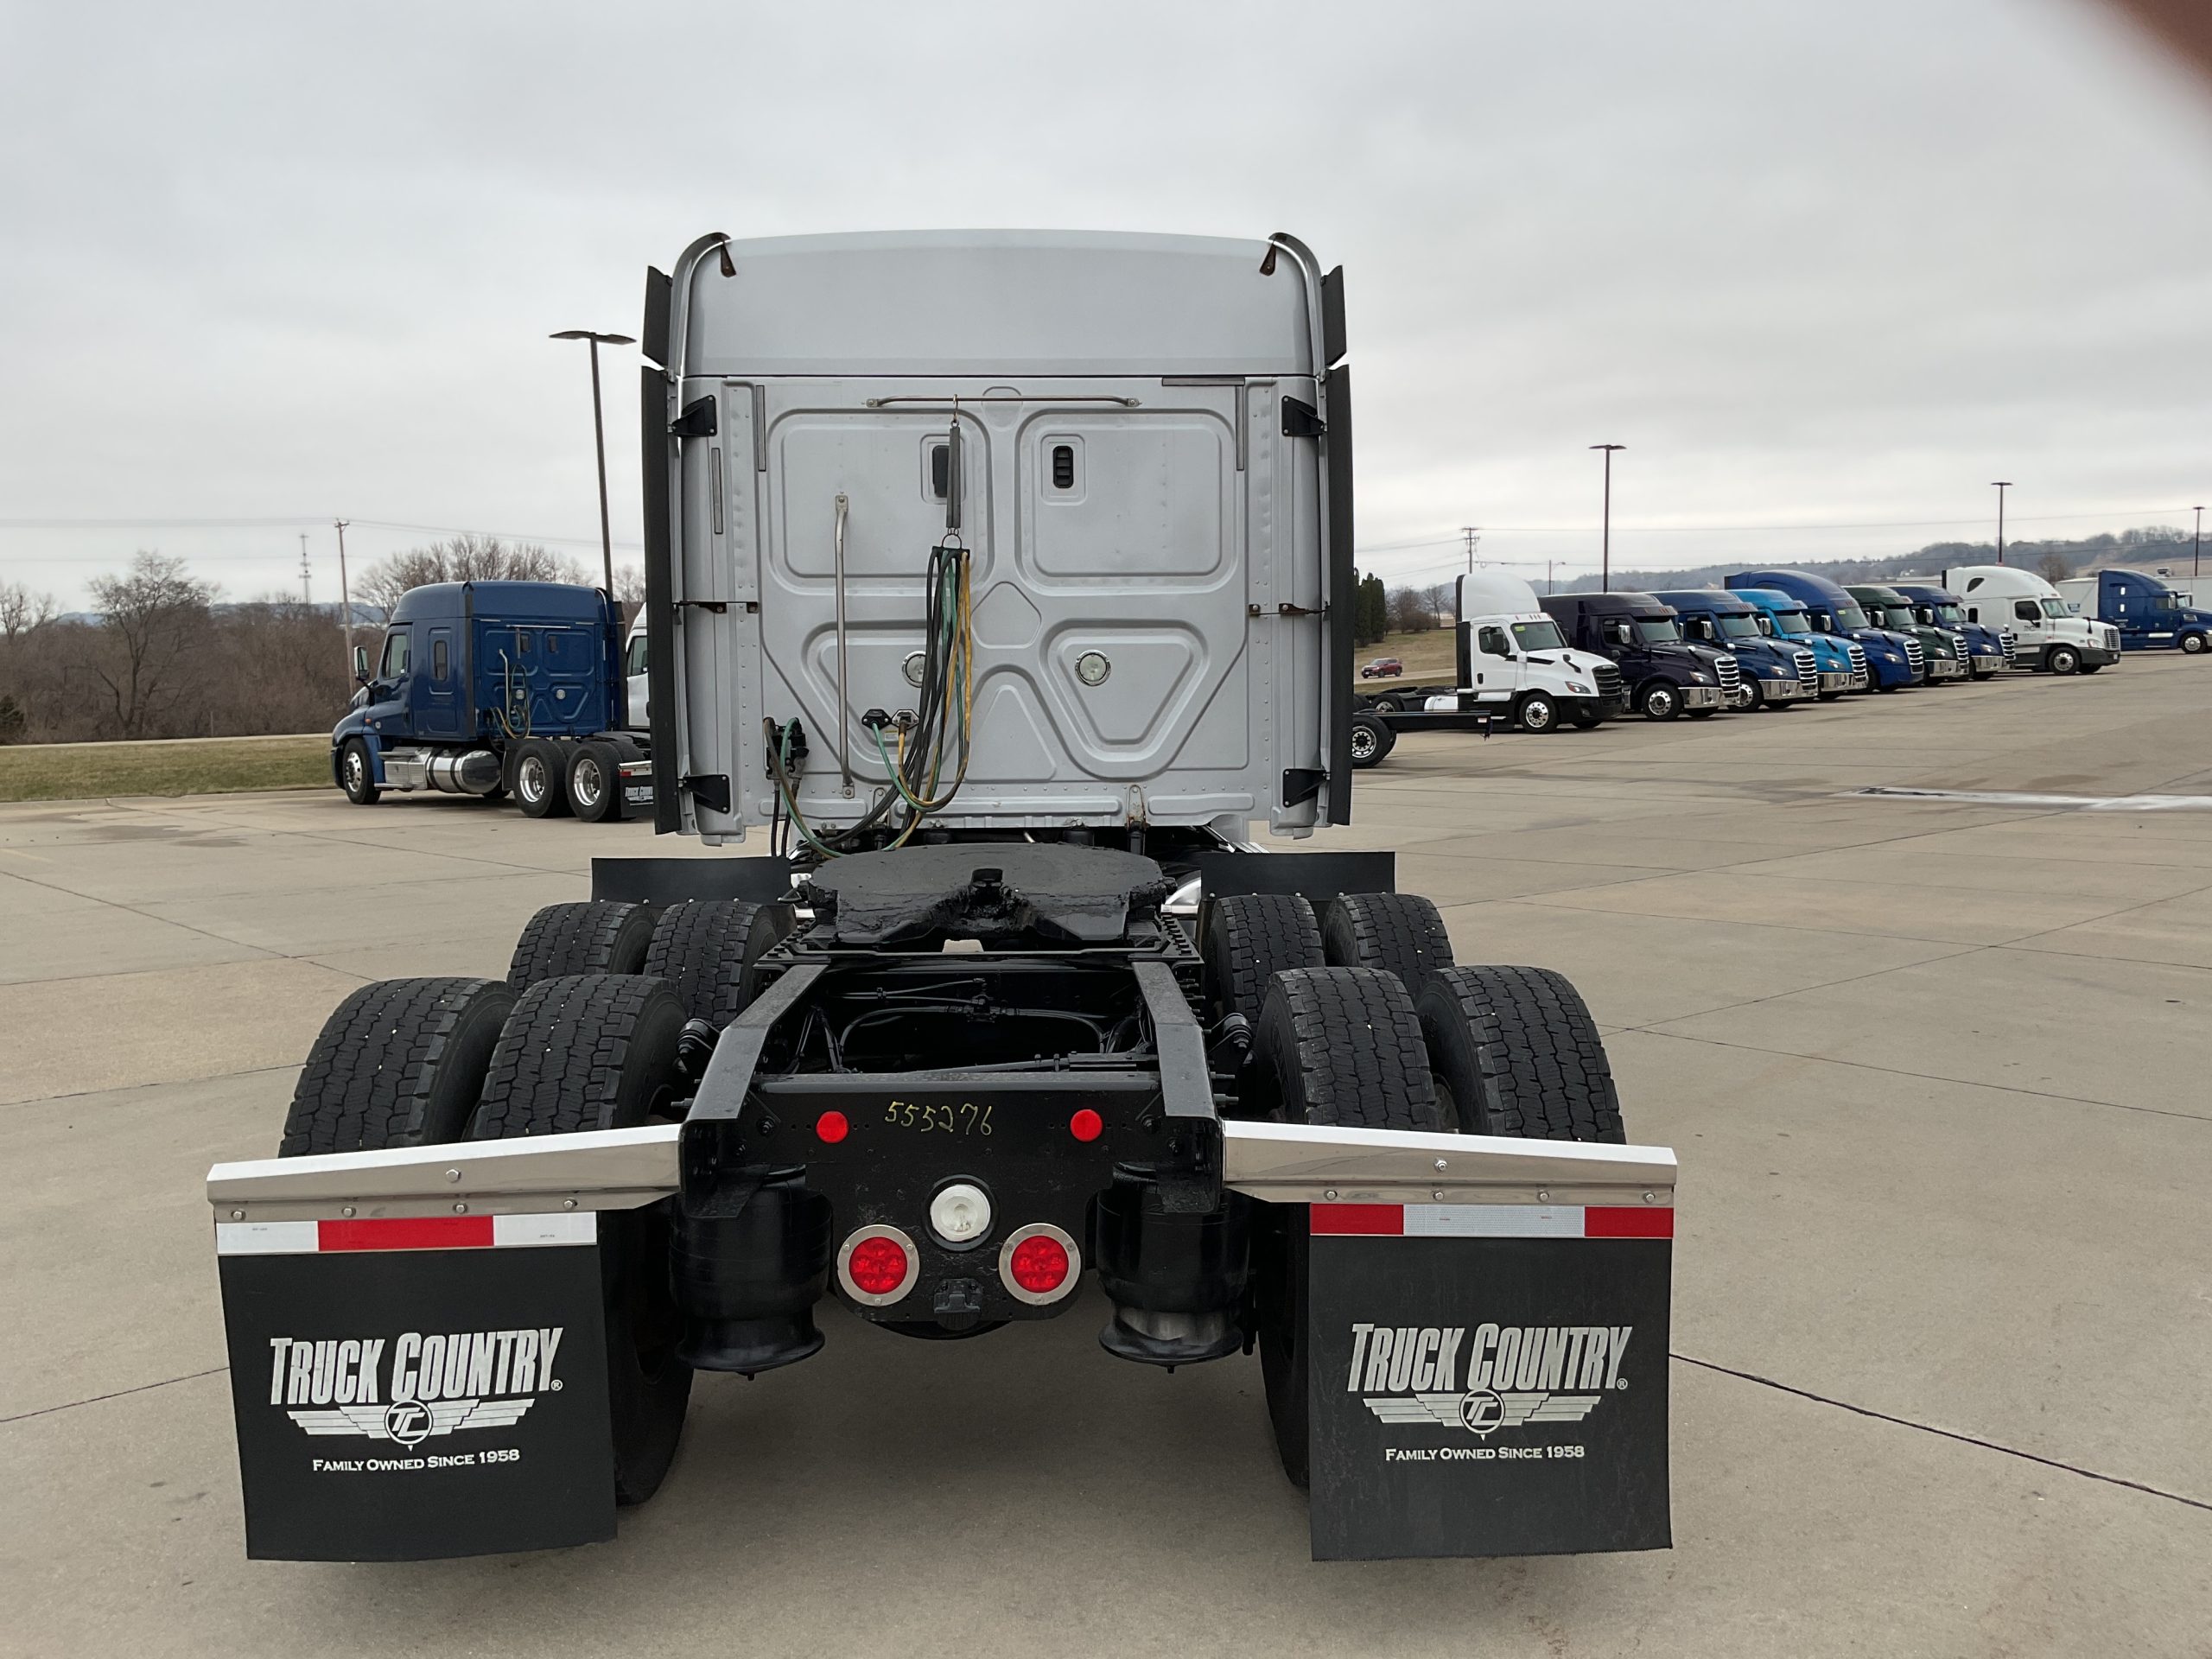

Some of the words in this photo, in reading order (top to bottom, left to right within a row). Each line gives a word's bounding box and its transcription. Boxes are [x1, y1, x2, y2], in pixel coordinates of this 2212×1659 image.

[884, 1101, 993, 1135] 555276
[270, 1337, 386, 1405] TRUCK
[1347, 1323, 1465, 1391] TRUCK
[313, 1459, 365, 1471] FAMILY
[366, 1458, 425, 1471] OWNED
[427, 1453, 475, 1469] SINCE
[479, 1448, 520, 1464] 1958
[1385, 1448, 1439, 1461] FAMILY
[1440, 1447, 1497, 1461] OWNED
[1497, 1446, 1542, 1459] SINCE
[1546, 1445, 1585, 1459] 1958
